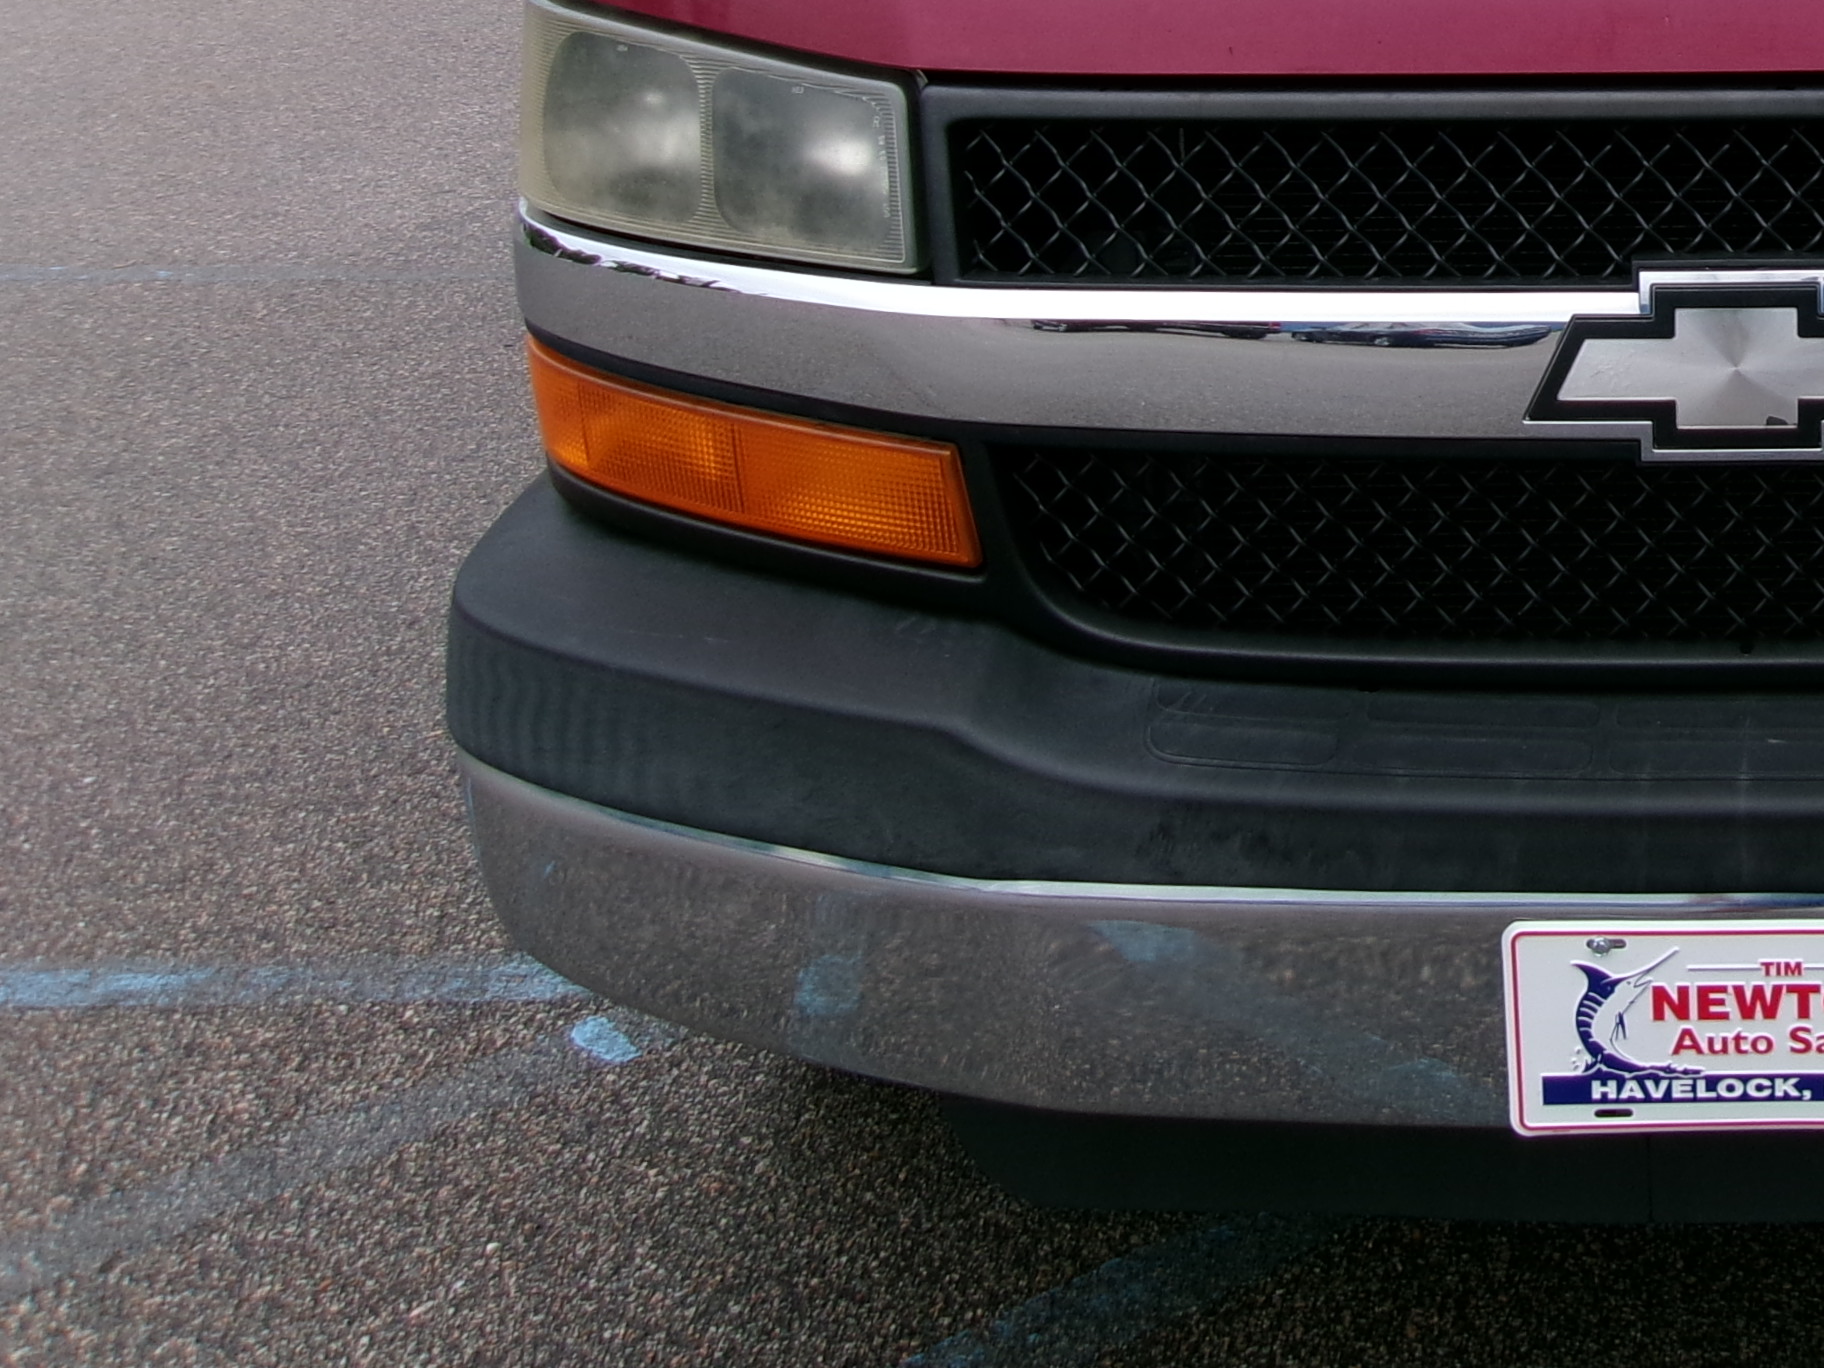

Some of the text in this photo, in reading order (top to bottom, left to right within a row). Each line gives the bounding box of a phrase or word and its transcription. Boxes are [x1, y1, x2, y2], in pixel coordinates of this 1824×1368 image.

[1761, 961, 1803, 976] TIM
[1671, 1028, 1774, 1055] Auto
[1591, 1078, 1812, 1100] HAVELOCK,
